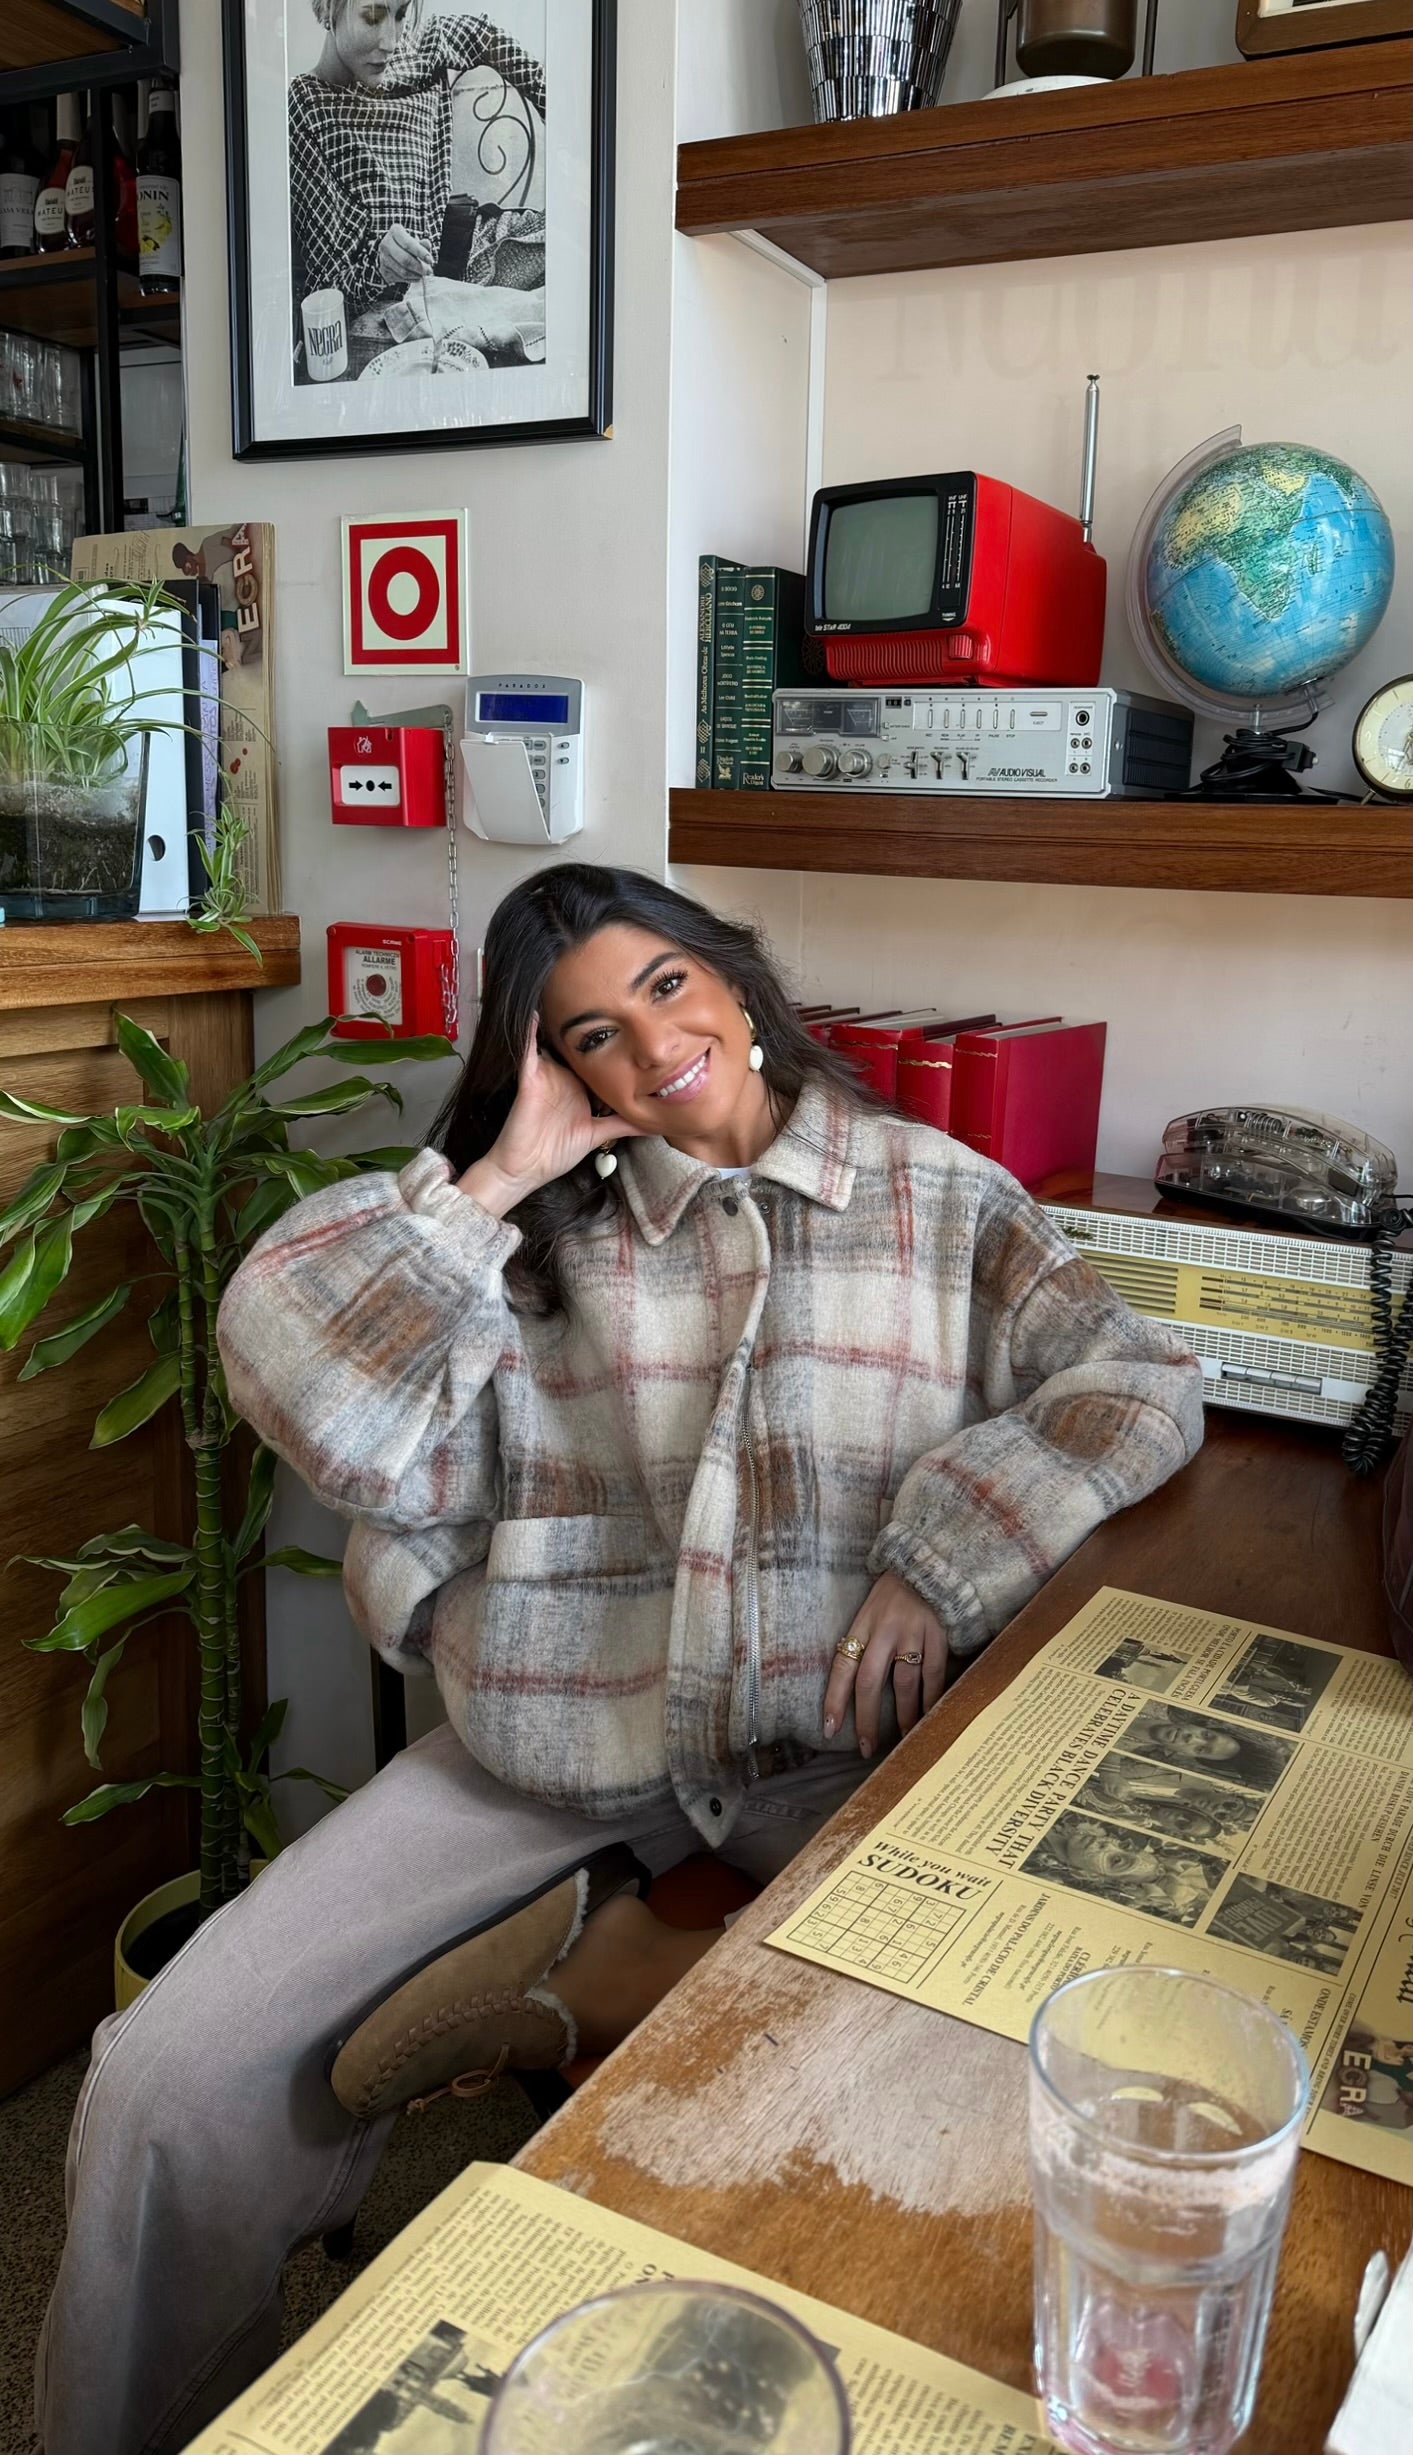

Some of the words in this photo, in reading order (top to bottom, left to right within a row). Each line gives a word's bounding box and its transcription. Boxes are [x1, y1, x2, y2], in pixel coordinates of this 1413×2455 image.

[138, 190, 169, 200] ONIN
[232, 523, 262, 665] NEGRA
[704, 593, 712, 643] HERCULANO
[363, 956, 396, 965] ALLARME
[1198, 1636, 1221, 1659] MELHOR
[1180, 1667, 1212, 1702] PORTUGUESA
[1183, 1664, 1201, 1680] FALA
[1125, 1691, 1144, 1702] A
[1169, 1678, 1191, 1699] INGLÊS
[1067, 1687, 1129, 1751] CELEBRATES
[1089, 1702, 1137, 1749] DAYTIME
[1035, 1749, 1079, 1791] BLACK
[1057, 1749, 1100, 1790] DANCE
[1391, 1770, 1409, 1794] DANIEL
[1024, 1790, 1068, 1832] PARTY
[1382, 1792, 1400, 1816] BISKUP
[1390, 1803, 1409, 1828] PARADE
[981, 1789, 1047, 1857] DIVERSITY
[1369, 1812, 1392, 1844] GESEHEN
[994, 1831, 1036, 1870] THAT
[1379, 1827, 1399, 1852] DURCH
[873, 1841, 920, 1863] While
[921, 1860, 952, 1875] you
[954, 1870, 993, 1888] wait
[1373, 1852, 1388, 1869] DIE
[857, 1854, 986, 1902] SUDOKU
[1363, 1867, 1381, 1893] LINSE
[1023, 1892, 1051, 1922] JARDINS
[1356, 1892, 1372, 1910] VON
[1016, 1920, 1031, 1933] DO
[992, 1931, 1025, 1965] PALÁCIO
[1066, 1945, 1083, 1963] BAIXA
[984, 1962, 1000, 1976] DE
[1060, 1960, 1073, 1972] DO
[960, 1973, 993, 2008] CRISTAL
[1048, 1969, 1067, 1991] PORTO
[1313, 1986, 1332, 2012] ONDE
[1296, 2009, 1322, 2050] ESTAMOS
